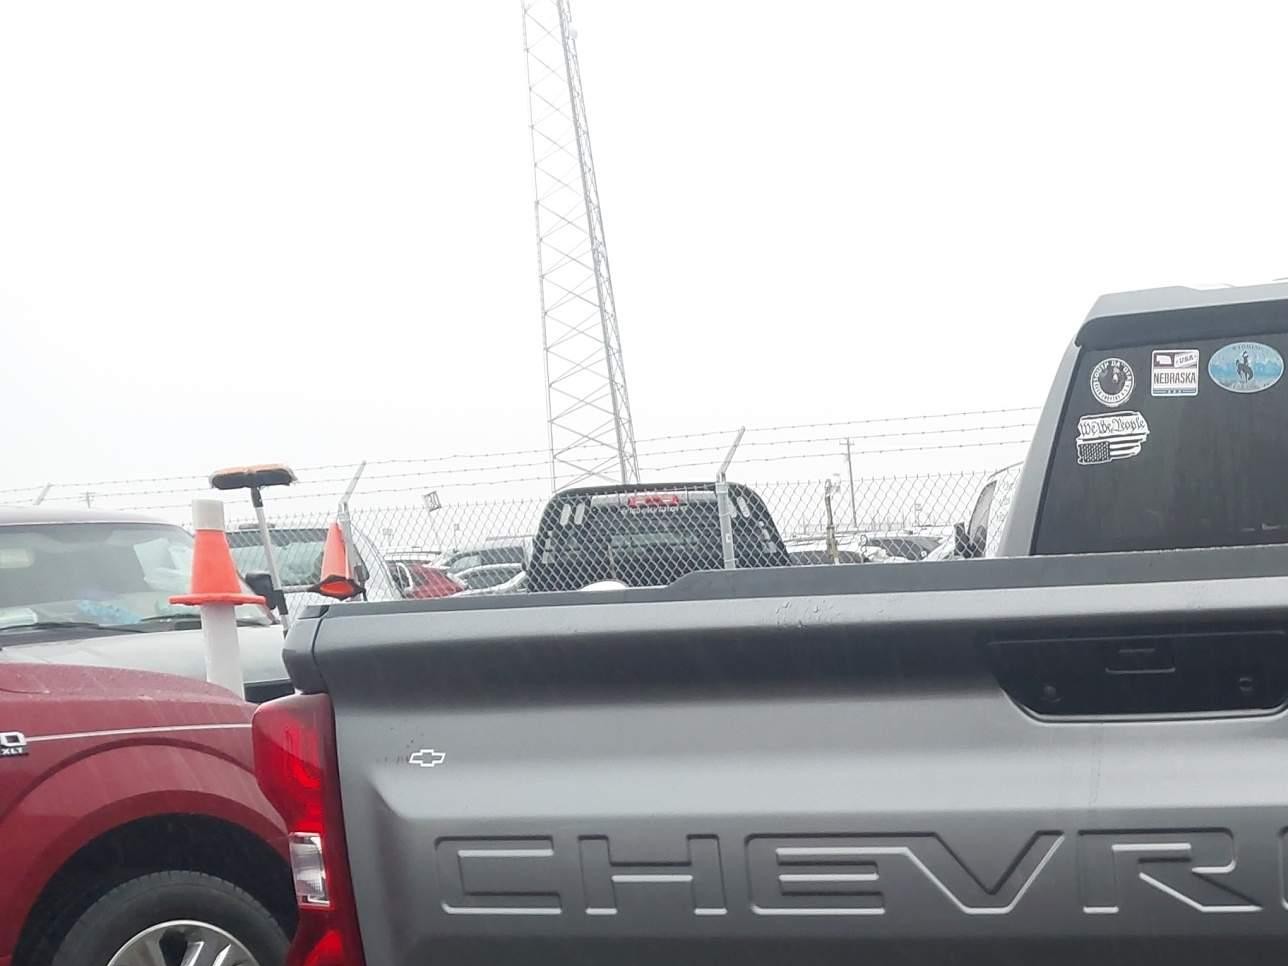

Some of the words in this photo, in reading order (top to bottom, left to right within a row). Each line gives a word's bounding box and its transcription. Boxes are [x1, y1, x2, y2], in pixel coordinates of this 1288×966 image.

[1178, 354, 1194, 364] USA
[1153, 372, 1196, 384] NEBRASKA
[1080, 421, 1097, 437] We
[1112, 416, 1145, 432] People
